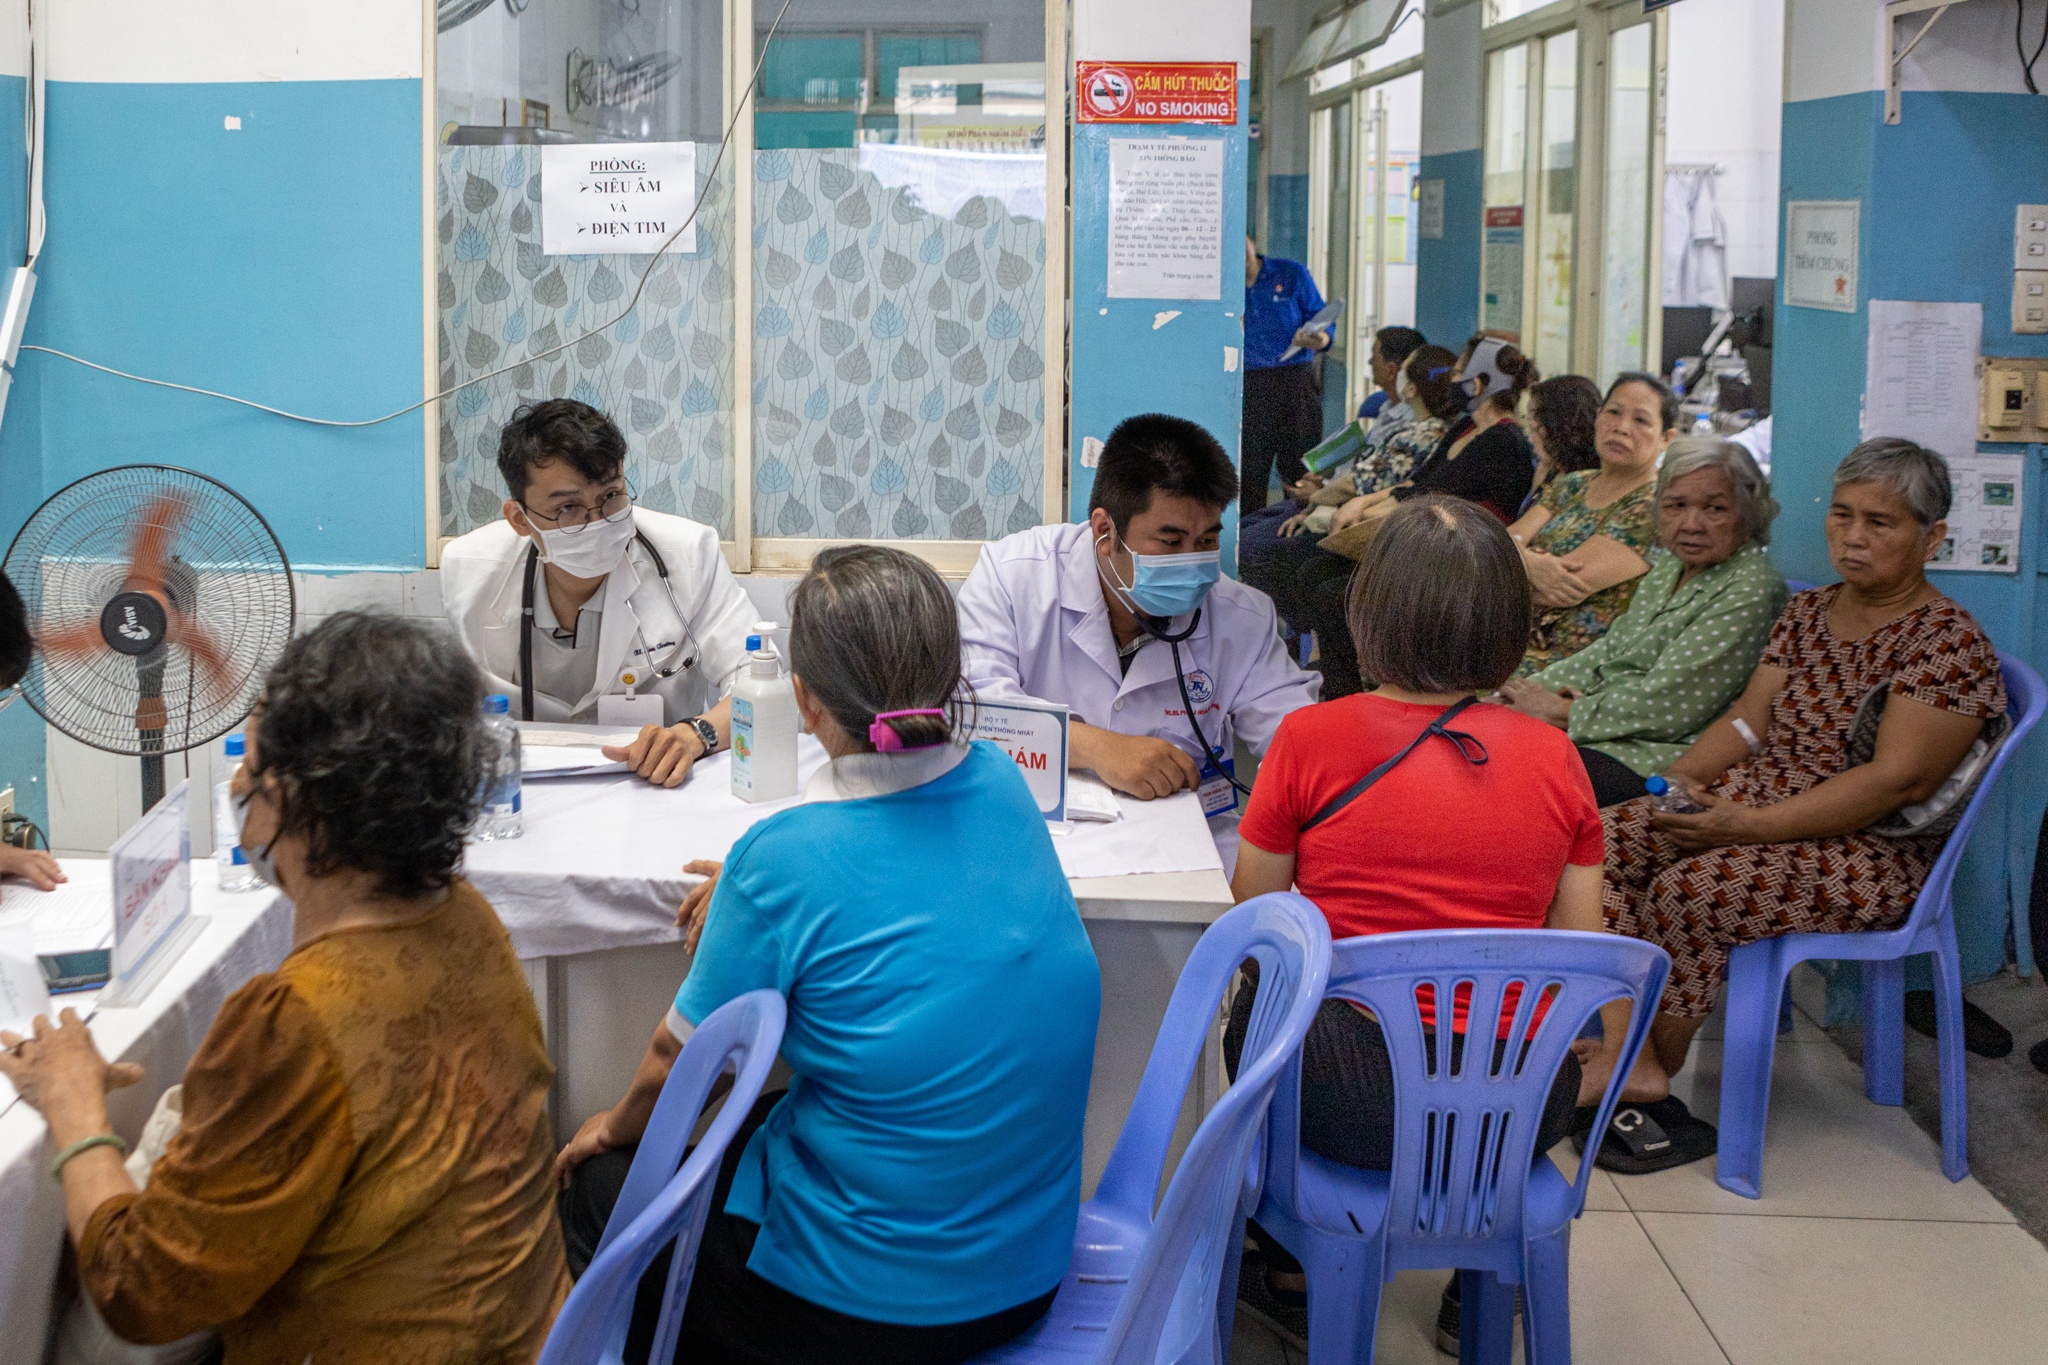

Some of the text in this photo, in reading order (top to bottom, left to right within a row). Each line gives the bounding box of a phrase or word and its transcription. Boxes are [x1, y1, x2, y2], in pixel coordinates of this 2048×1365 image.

[1134, 70, 1230, 91] CẤM HÚT THUỐC
[1134, 102, 1229, 116] NO SMOKING
[1128, 144, 1149, 152] TRẠM
[590, 157, 646, 172] PHÒNG:
[594, 177, 661, 193] SIÊU ÂM
[610, 200, 627, 213] VÀ
[592, 221, 666, 237] ĐIỆN TIM
